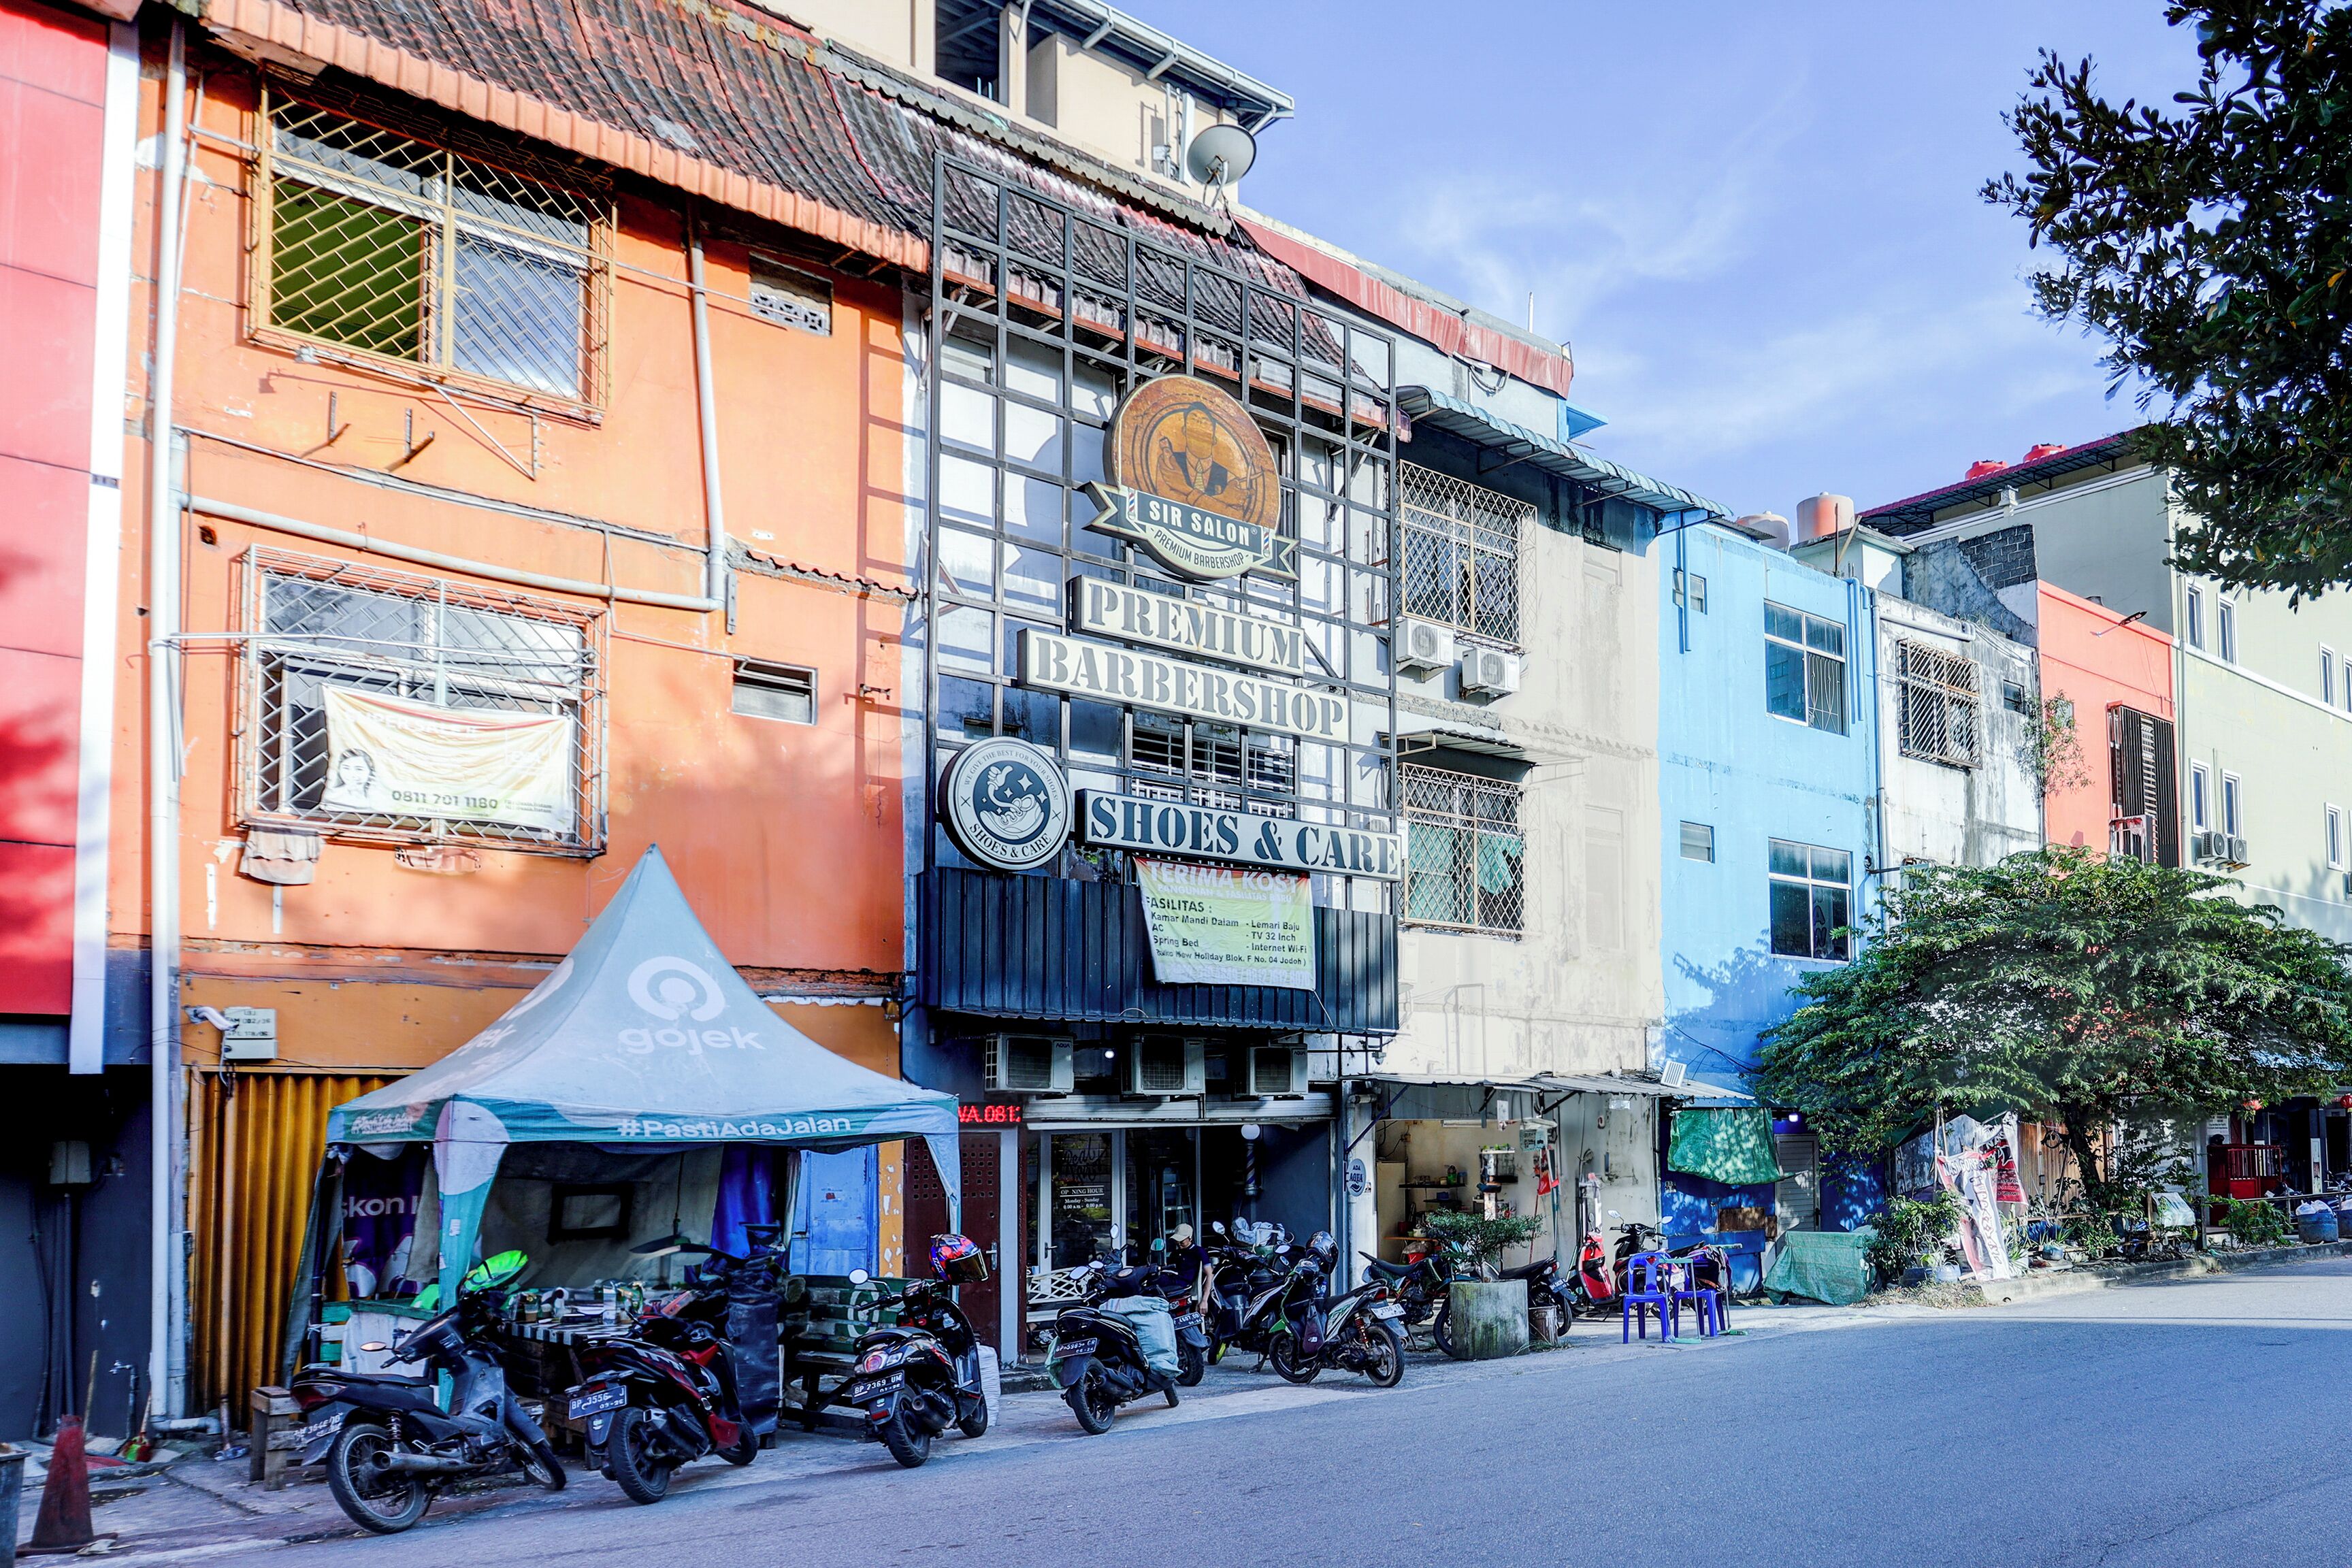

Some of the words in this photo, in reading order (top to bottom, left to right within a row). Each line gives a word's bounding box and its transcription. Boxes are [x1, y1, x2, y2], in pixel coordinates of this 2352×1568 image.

[1149, 500, 1182, 528] SIR
[1191, 512, 1250, 546] SALON
[1154, 529, 1192, 563] PREMIUM
[1194, 552, 1244, 569] BARBERSHOP
[1088, 583, 1302, 669] PREMIUM
[1036, 637, 1343, 736] BARBERSHOP
[964, 775, 972, 786] WE
[970, 759, 983, 774] GIVE
[982, 751, 996, 762] THE
[1015, 751, 1030, 761] FOR
[1029, 758, 1046, 774] YOUR
[1044, 775, 1059, 801] SHOES!
[392, 791, 427, 803] 0811
[433, 794, 459, 806] 701
[464, 796, 498, 810] 1180
[970, 823, 1007, 856] SHOES
[1010, 848, 1019, 858] &
[1022, 833, 1052, 857] CARE
[1091, 796, 1239, 855] SHOES
[1254, 821, 1282, 861] &
[1296, 826, 1399, 875] CARE
[1146, 861, 1235, 889] TERIMA
[1243, 871, 1298, 894] KOST
[1226, 891, 1267, 900] FASILITAS
[1151, 912, 1179, 922] Kamar
[1181, 915, 1209, 926] Mandi
[1211, 917, 1239, 928] Dalam
[1152, 924, 1164, 932] AC
[1251, 920, 1280, 930] Lemari
[1283, 922, 1300, 932] Baju
[1154, 935, 1179, 947] Spring
[1182, 938, 1198, 947] Bed
[1252, 943, 1286, 953] Internet
[1288, 945, 1307, 953] Wi-Fi
[1194, 953, 1223, 962] Holiday
[1279, 957, 1301, 965] Jodoh
[617, 1026, 767, 1055] gojek
[617, 1117, 851, 1138] #PastiAdaJalan
[1349, 1173, 1363, 1183] AQUA
[854, 1386, 864, 1394] BP
[571, 1399, 582, 1410] BP
